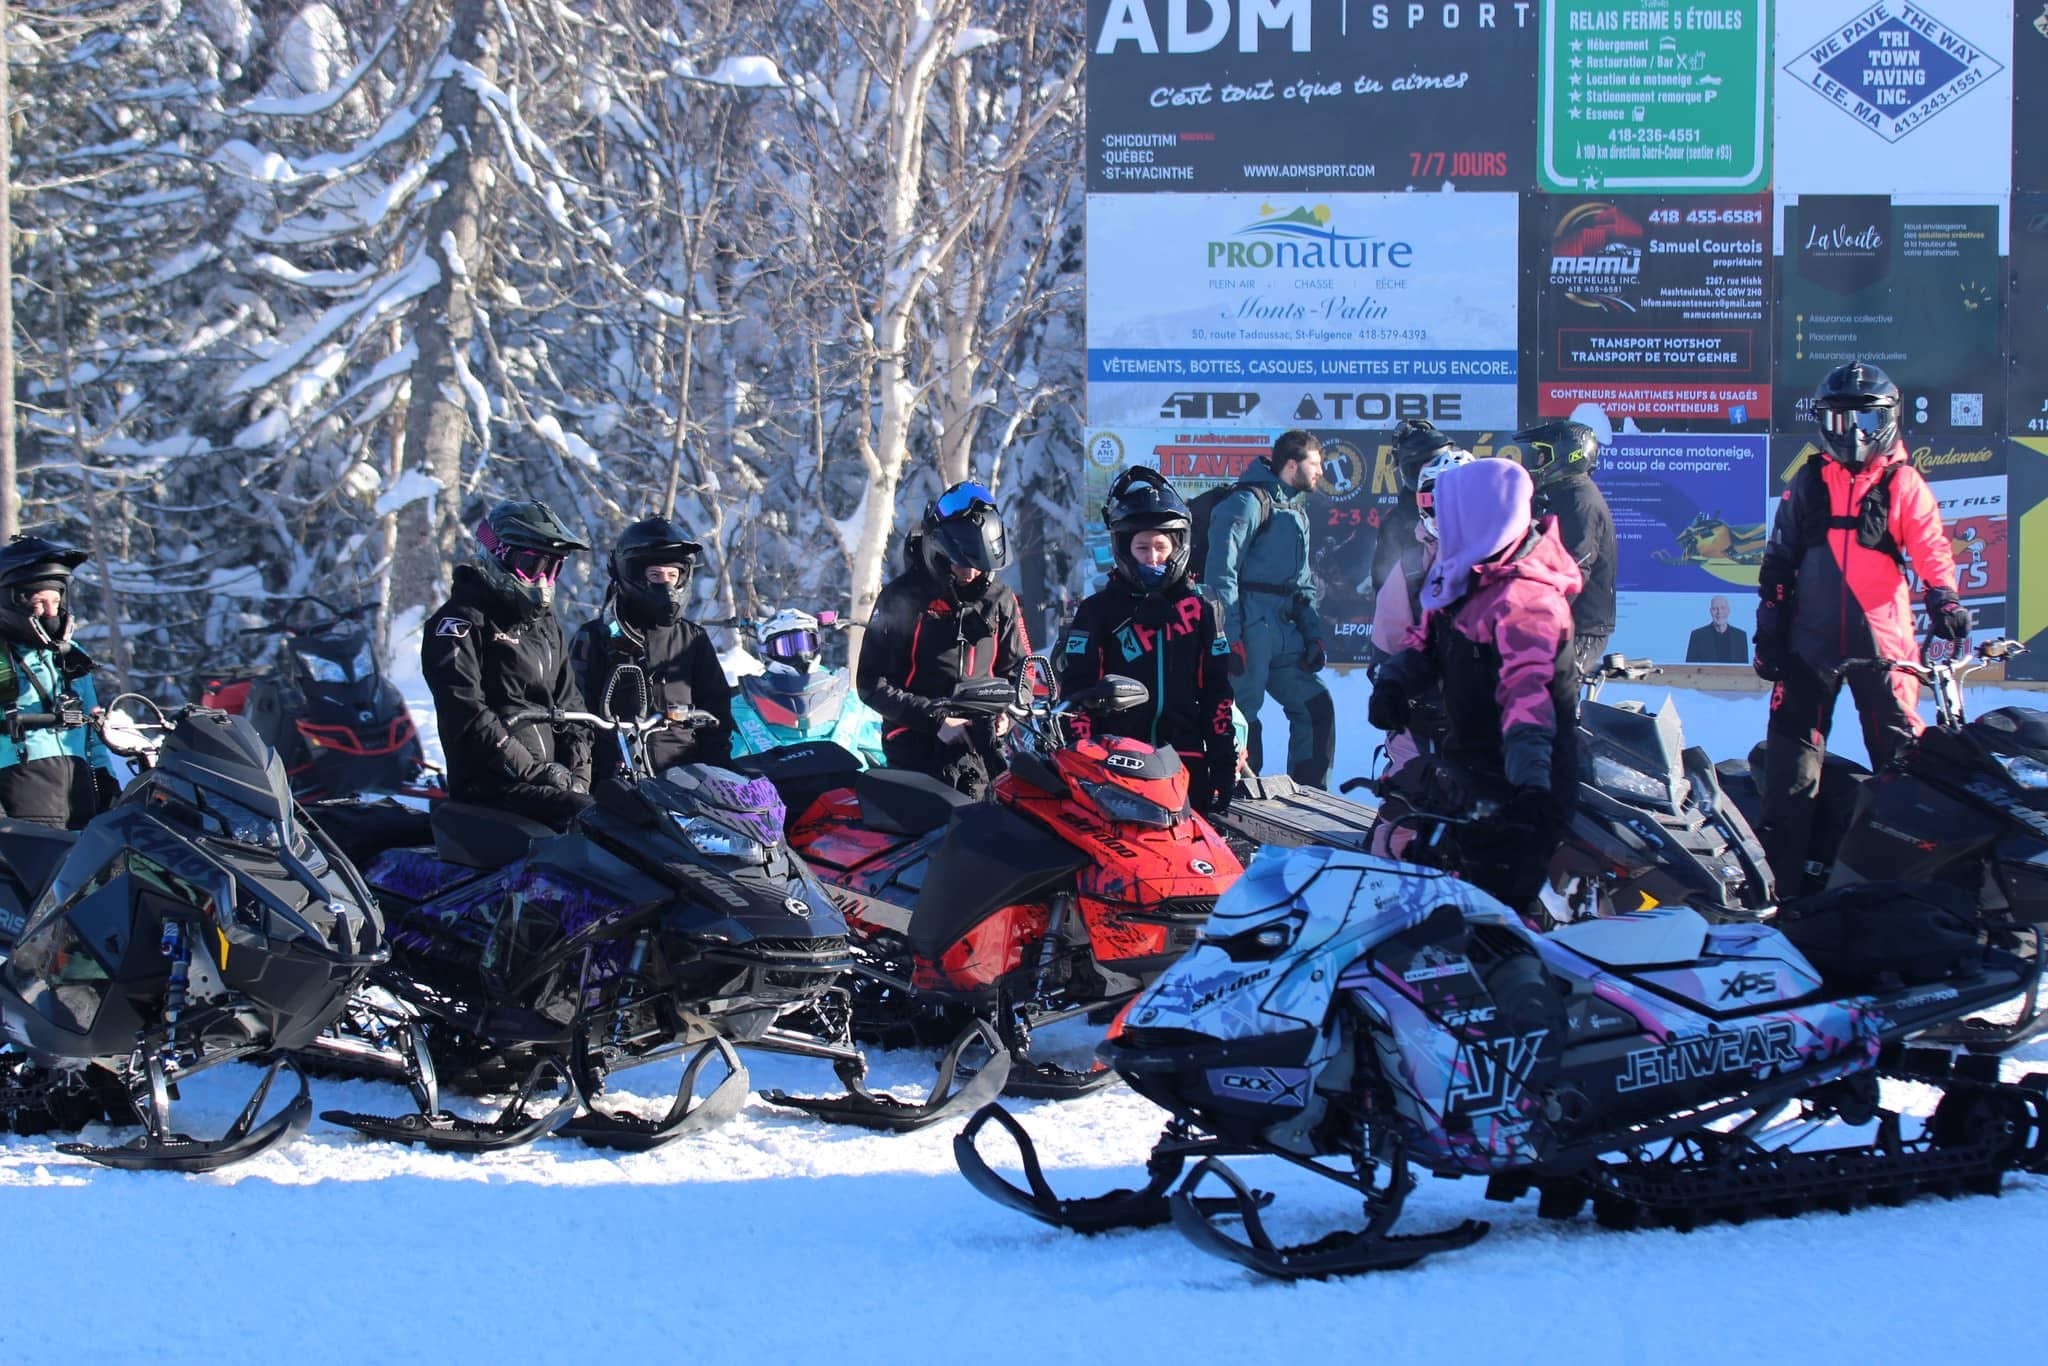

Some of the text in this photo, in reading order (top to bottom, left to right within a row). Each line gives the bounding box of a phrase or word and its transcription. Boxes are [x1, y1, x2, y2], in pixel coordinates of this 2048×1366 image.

[1569, 6, 1742, 31] RELAIS FERME 5 ÉTOILES
[1096, 0, 1530, 54] ADM SPORT
[1810, 4, 1980, 66] WE PAVE THE WAY
[1878, 31, 1910, 48] TRI
[1587, 38, 1649, 53] Hébergement
[1586, 55, 1647, 69] Restauration
[1657, 56, 1674, 69] Bar
[1868, 50, 1921, 67] TOWN
[1586, 72, 1692, 88] Location de motoneige
[1863, 69, 1926, 86] PAVING
[1150, 86, 1213, 108] C'est
[1221, 81, 1275, 102] tout
[1354, 73, 1383, 94] tu
[1391, 72, 1469, 92] aimes
[1586, 90, 1702, 105] Stationnement remorque
[1876, 88, 1911, 105] INC.
[1894, 68, 1984, 134] 413-243-1551
[1586, 107, 1625, 121] Essence
[1853, 101, 1881, 128] MA
[1106, 134, 1177, 147] CHICOUTIMI
[1608, 128, 1701, 142] 418-236-4551
[1105, 148, 1155, 164] QUÉBEC
[1597, 143, 1608, 160] km
[1610, 143, 1641, 160] direction
[1243, 164, 1376, 178] WWW.ADMSPORT.COM
[1410, 151, 1508, 177] 7/7 JOURS
[1105, 166, 1194, 180] ST-HYACINTHE
[1649, 209, 1763, 225] 418 455-6581
[1904, 223, 1922, 231] Nous
[1804, 223, 1830, 250] La
[1918, 240, 1946, 248] hauteur
[1946, 240, 1957, 248] de
[1207, 225, 1413, 269] PROnature
[1650, 239, 1763, 254] Samuel Courtois
[1713, 256, 1763, 268] propriétaire
[1209, 279, 1236, 289] PLEIN
[1238, 279, 1256, 289] AIR
[1294, 279, 1335, 290] CHASSE
[1550, 275, 1616, 285] CONTENEURS
[1726, 277, 1739, 286] rue
[1568, 285, 1582, 293] 418
[1714, 287, 1727, 297] QC
[1808, 313, 1894, 324] Assurance collective
[1209, 329, 1237, 340] route
[1239, 328, 1293, 341] Tadoussac,
[1295, 328, 1353, 343] St-Fulgence
[1358, 329, 1427, 340] 418-579-4393
[1809, 333, 1858, 342] Placements
[1590, 338, 1722, 349] TRANSPORT HOTSHOT
[1571, 352, 1738, 363] TRANSPORT DE TOUT GENRE
[1808, 351, 1908, 361] Assurances individuelles
[1102, 355, 1188, 376] VÊTEMENTS,
[1189, 359, 1247, 376] BOTTES,
[1248, 359, 1318, 377] CASQUES,
[1321, 359, 1389, 376] LUNETTES
[1393, 360, 1410, 376] ET
[1413, 360, 1447, 376] PLUS
[1550, 388, 1617, 399] CONTENEURS
[1618, 390, 1674, 400] MARITIMES
[1676, 391, 1708, 401] NEUFS
[1323, 393, 1462, 421] TOBE
[1600, 403, 1720, 413] CATION DE CONTENEURS
[1100, 440, 1112, 449] 25
[1621, 447, 1683, 458] assurance
[1686, 445, 1755, 459] motoneige,
[1603, 458, 1731, 474] le coup de comparer.
[1963, 495, 2001, 507] FILS
[1190, 968, 1271, 1013] ski-doo
[1719, 970, 1777, 1001] XPS
[1223, 1075, 1274, 1092] CKX
